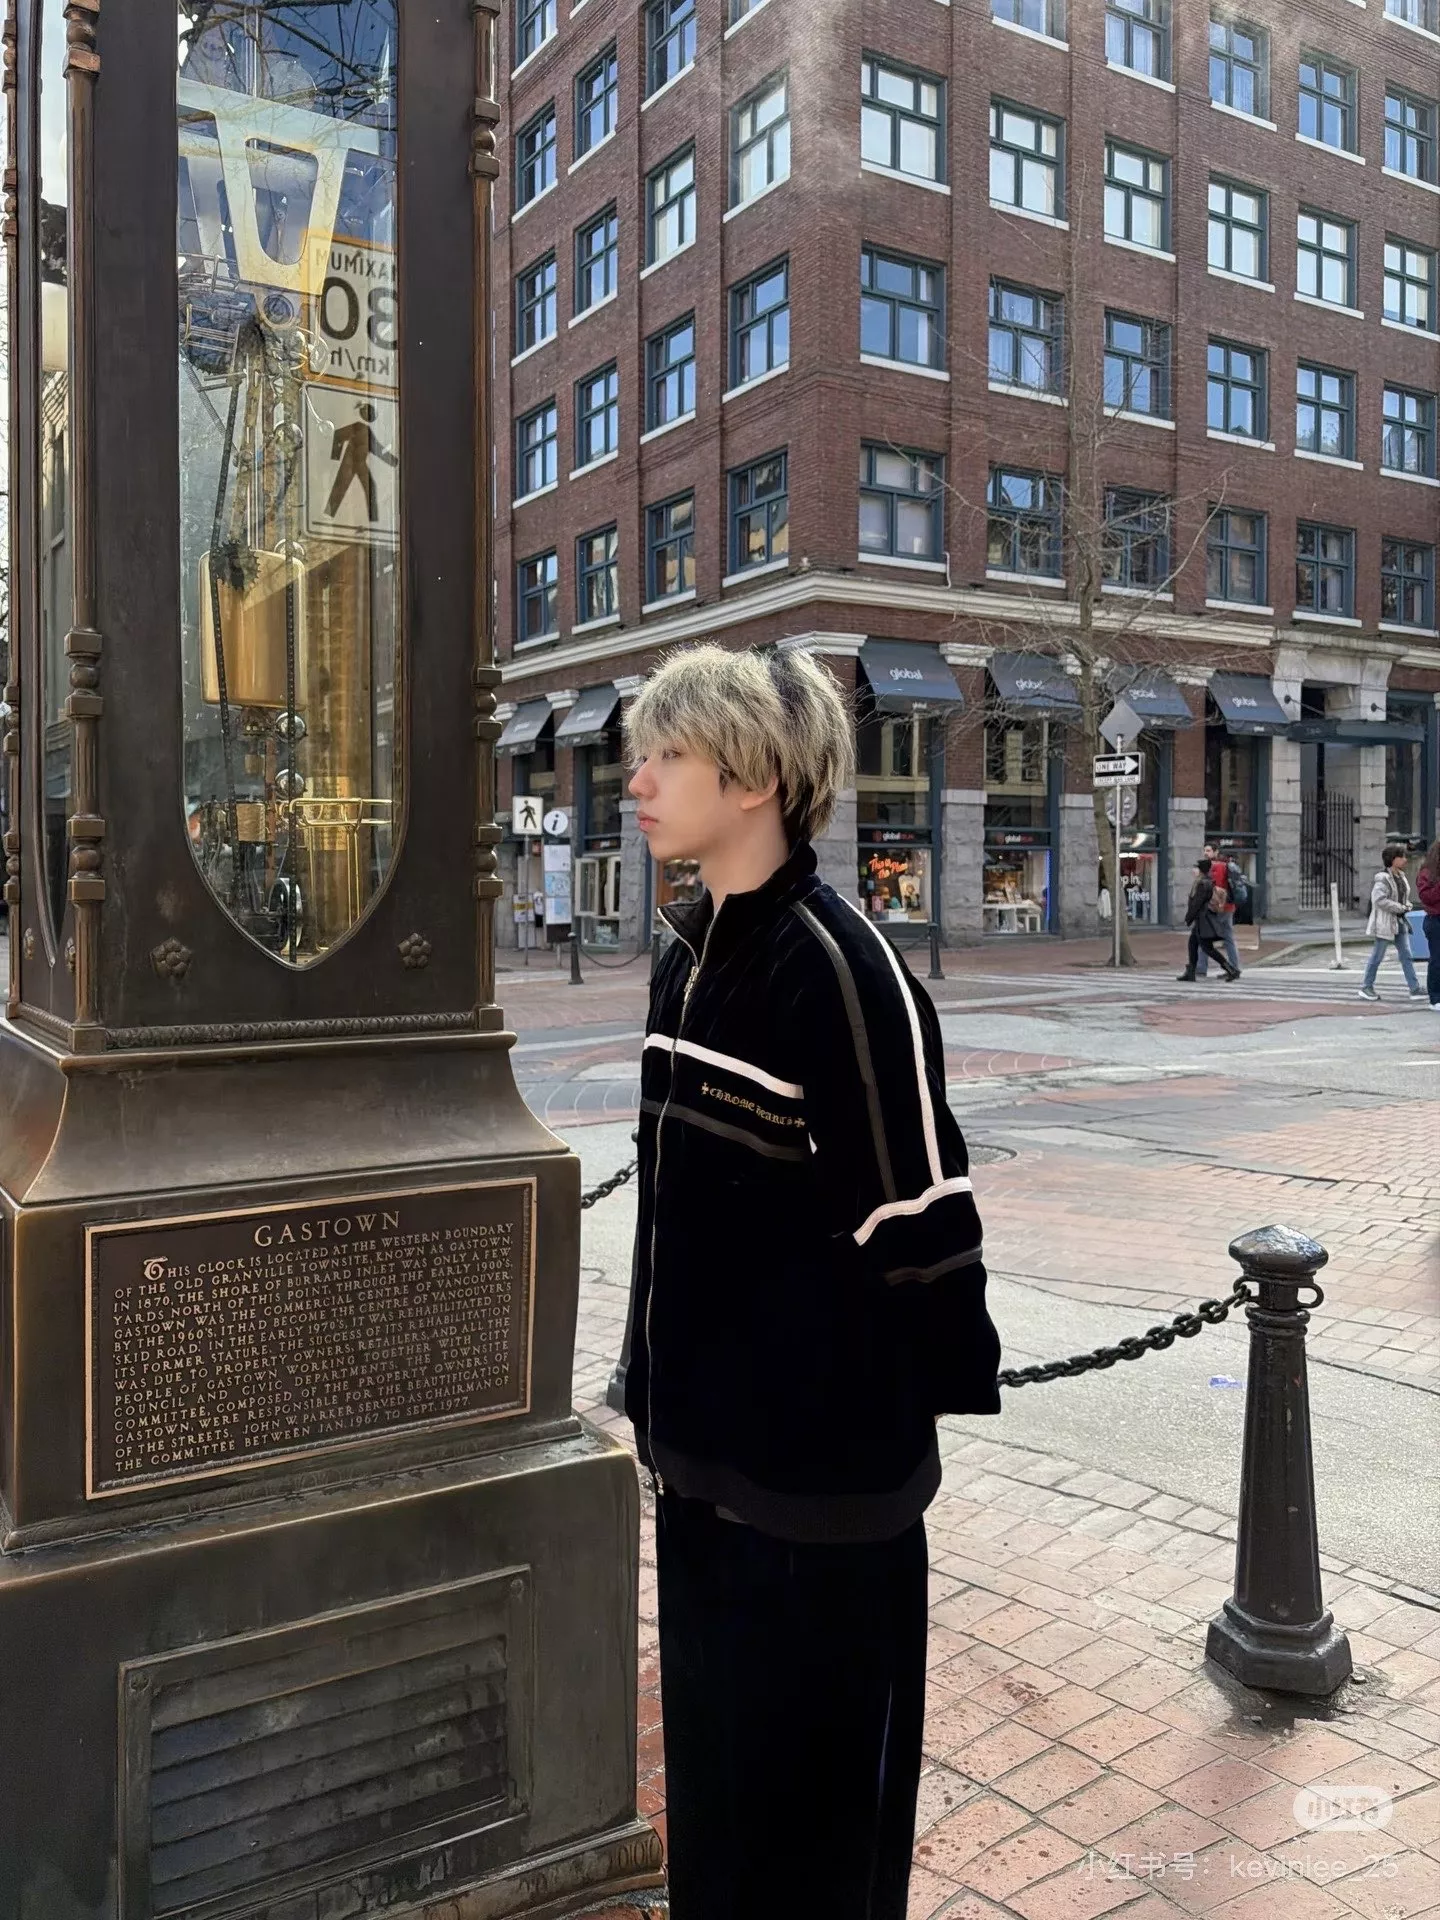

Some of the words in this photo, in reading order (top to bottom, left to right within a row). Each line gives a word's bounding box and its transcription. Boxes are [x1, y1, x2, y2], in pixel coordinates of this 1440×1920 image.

[889, 668, 923, 680] global
[1112, 761, 1127, 770] WAY
[143, 1254, 190, 1280] THIS
[198, 1258, 245, 1273] CLOCK
[250, 1256, 261, 1266] IS
[267, 1247, 327, 1264] LOCATED
[333, 1244, 348, 1255] AT
[352, 1241, 375, 1253] THE
[382, 1233, 439, 1249] WESTERN
[445, 1223, 513, 1240] BOUNDARY
[254, 1209, 399, 1247] GASTOWN
[113, 1301, 129, 1313] IN
[179, 1290, 203, 1303] THE
[212, 1282, 259, 1299] SHORE
[265, 1279, 281, 1291] OF
[287, 1269, 351, 1288] BURRARD
[357, 1263, 394, 1277] INLET
[402, 1258, 426, 1271] WAS
[433, 1253, 466, 1266] ONLY
[472, 1251, 479, 1261] A
[484, 1246, 510, 1259] FEW
[113, 1309, 163, 1326] YARDS
[171, 1301, 221, 1317] NORTH
[228, 1297, 243, 1309] OF
[250, 1292, 280, 1305] THIS
[336, 1275, 396, 1293] THROUGH
[400, 1271, 422, 1283] THE
[431, 1264, 470, 1279] EARLY
[115, 1287, 131, 1298] OF
[139, 1282, 166, 1295] THE
[174, 1277, 202, 1290] OLD
[212, 1265, 292, 1285] GRANVILLE
[376, 1247, 424, 1262] KNOWN
[430, 1244, 443, 1255] AS
[450, 1235, 513, 1252] GASTOWN.
[114, 1319, 185, 1339] GASTOWN
[195, 1313, 224, 1326] WAS
[232, 1308, 256, 1321] THE
[264, 1294, 351, 1316] COMMERCIAL
[358, 1285, 408, 1302] CENTRE
[416, 1282, 431, 1293] OF
[114, 1340, 130, 1352] BY
[138, 1335, 163, 1348] THE
[221, 1324, 233, 1335] IT
[238, 1319, 266, 1333] HAD
[273, 1310, 324, 1327] BECOME
[331, 1305, 354, 1318] THE
[359, 1297, 408, 1314] CENTRE
[413, 1294, 427, 1305] OF
[431, 1281, 511, 1302] VANCOUVER'S
[114, 1366, 134, 1378] ITS
[143, 1354, 204, 1373] FORMER
[280, 1338, 303, 1351] THE
[309, 1329, 361, 1346] SUCCESS
[366, 1326, 381, 1337] OF
[386, 1322, 402, 1334] ITS
[408, 1305, 510, 1330] REHABILITATION
[209, 1338, 223, 1349] IN
[230, 1333, 254, 1346] THE
[260, 1326, 302, 1341] EARLY
[352, 1316, 364, 1327] IT
[369, 1311, 392, 1324] WAS
[398, 1296, 491, 1319] REHABILITATED
[496, 1293, 511, 1304] TO
[113, 1396, 184, 1418] COUNCIL
[196, 1389, 227, 1403] AND
[242, 1379, 282, 1395] CIVIC
[406, 1354, 430, 1367] THE
[442, 1340, 508, 1360] TOWNSITE
[115, 1377, 146, 1392] WAS
[154, 1371, 182, 1385] DUE
[190, 1367, 207, 1379] TO
[216, 1354, 286, 1375] PROPERTY
[432, 1326, 456, 1338] AND
[461, 1321, 482, 1333] ALL
[487, 1317, 510, 1329] THE
[115, 1386, 171, 1405] PEOPLE
[180, 1382, 196, 1394] OF
[206, 1368, 277, 1389] GASTOWN
[286, 1355, 354, 1375] WORKING
[363, 1342, 431, 1362] TOGETHER
[438, 1335, 471, 1349] WITH
[479, 1329, 509, 1342] CITY
[114, 1405, 210, 1431] COMMITTEE,
[216, 1390, 291, 1413] COMPOSED
[301, 1386, 316, 1397] OF
[324, 1380, 348, 1393] THE
[358, 1366, 426, 1387] PROPERTY
[434, 1355, 488, 1373] OWNERS
[494, 1352, 508, 1363] OF
[115, 1445, 132, 1458] OF
[139, 1439, 164, 1454] THE
[171, 1427, 233, 1448] STREETS.
[242, 1418, 279, 1434] JOHN
[303, 1405, 353, 1423] PARKER
[358, 1395, 404, 1413] SERVED
[409, 1392, 421, 1403] AS
[425, 1379, 490, 1400] CHAIRMAN
[495, 1376, 508, 1387] OF
[199, 1413, 238, 1429] WERE
[247, 1395, 337, 1420] RESPONSIBLE
[345, 1389, 371, 1402] FOR
[378, 1383, 401, 1396] THE
[407, 1364, 509, 1391] BEAUTIFICATION
[115, 1457, 142, 1472] THE
[151, 1439, 234, 1465] COMMITTEE
[245, 1425, 309, 1447] BETWEEN
[350, 1412, 378, 1427] 1967
[385, 1408, 399, 1420] TO
